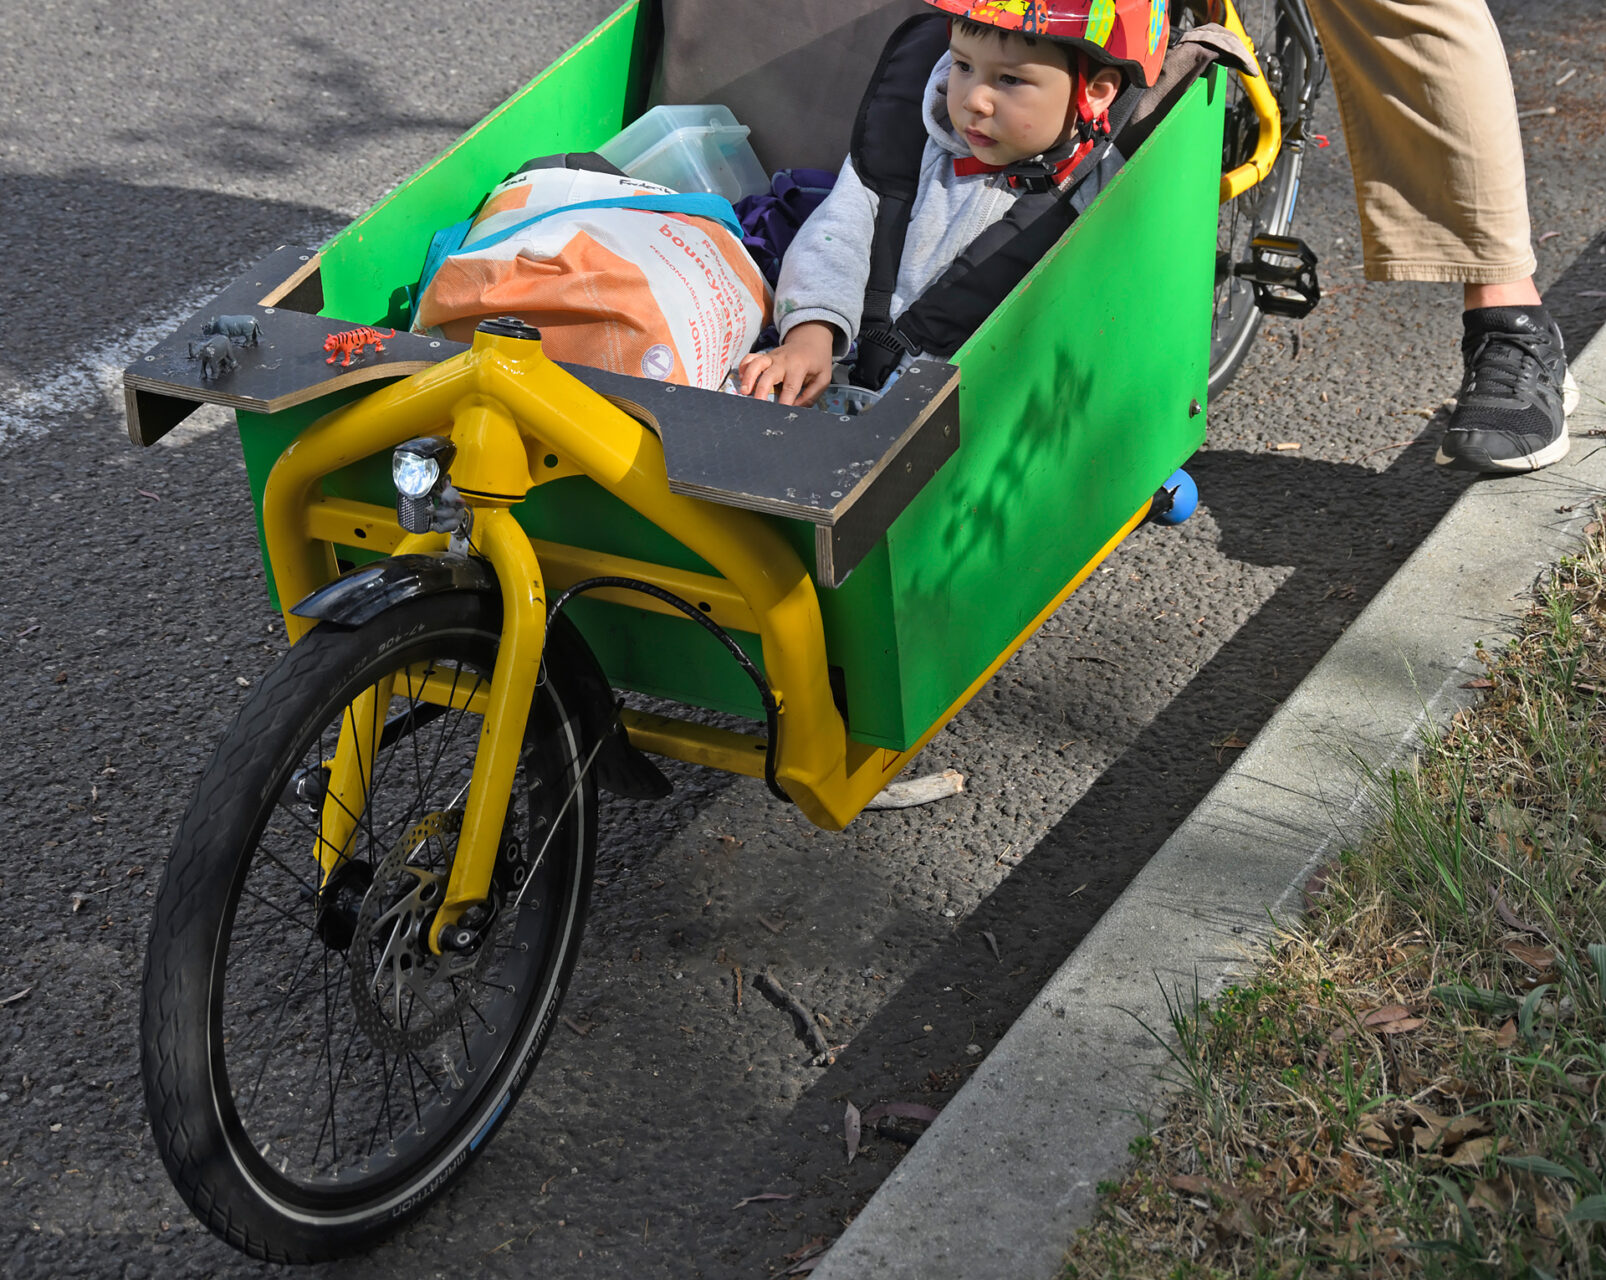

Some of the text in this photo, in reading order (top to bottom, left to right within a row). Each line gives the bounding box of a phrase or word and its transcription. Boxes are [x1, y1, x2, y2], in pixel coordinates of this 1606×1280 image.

[688, 319, 703, 361] JOIN
[513, 985, 560, 1089] SCHWALBE
[392, 1151, 467, 1218] MARATHON
